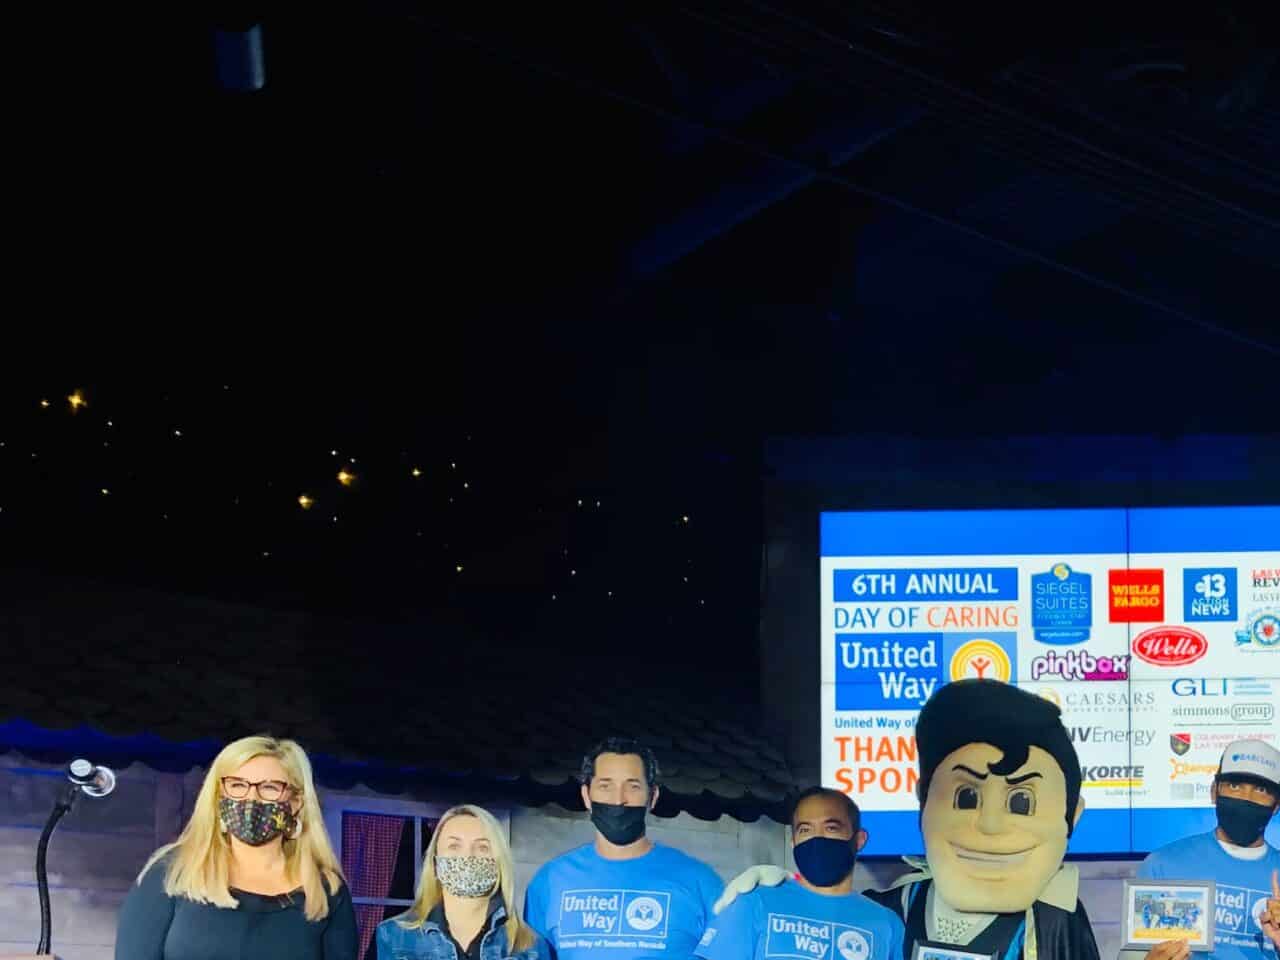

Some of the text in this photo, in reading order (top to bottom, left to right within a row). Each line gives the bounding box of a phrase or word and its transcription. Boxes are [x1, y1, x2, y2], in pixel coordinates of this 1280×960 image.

[851, 573, 998, 595] 6TH ANNUAL
[1035, 582, 1087, 595] SIEGEL
[1112, 584, 1160, 596] WELLS
[1035, 596, 1089, 610] SUITES
[1114, 597, 1160, 608] FARGO
[1191, 604, 1230, 616] NEWS
[834, 606, 1018, 629] DAY OF CARING
[839, 639, 938, 669] United
[1142, 638, 1199, 657] Wells
[1031, 650, 1132, 681] pinkbox
[877, 672, 938, 706] Way
[1171, 678, 1227, 697] GLI
[1065, 691, 1155, 705] CAESARS
[1172, 704, 1271, 718] simmons group
[835, 717, 917, 731] United Way of
[834, 736, 917, 763] THAN
[835, 767, 920, 795] SPON
[564, 896, 618, 912] United
[1215, 889, 1245, 909] ited
[582, 911, 616, 933] Way
[772, 918, 831, 939] United
[795, 935, 829, 959] Way
